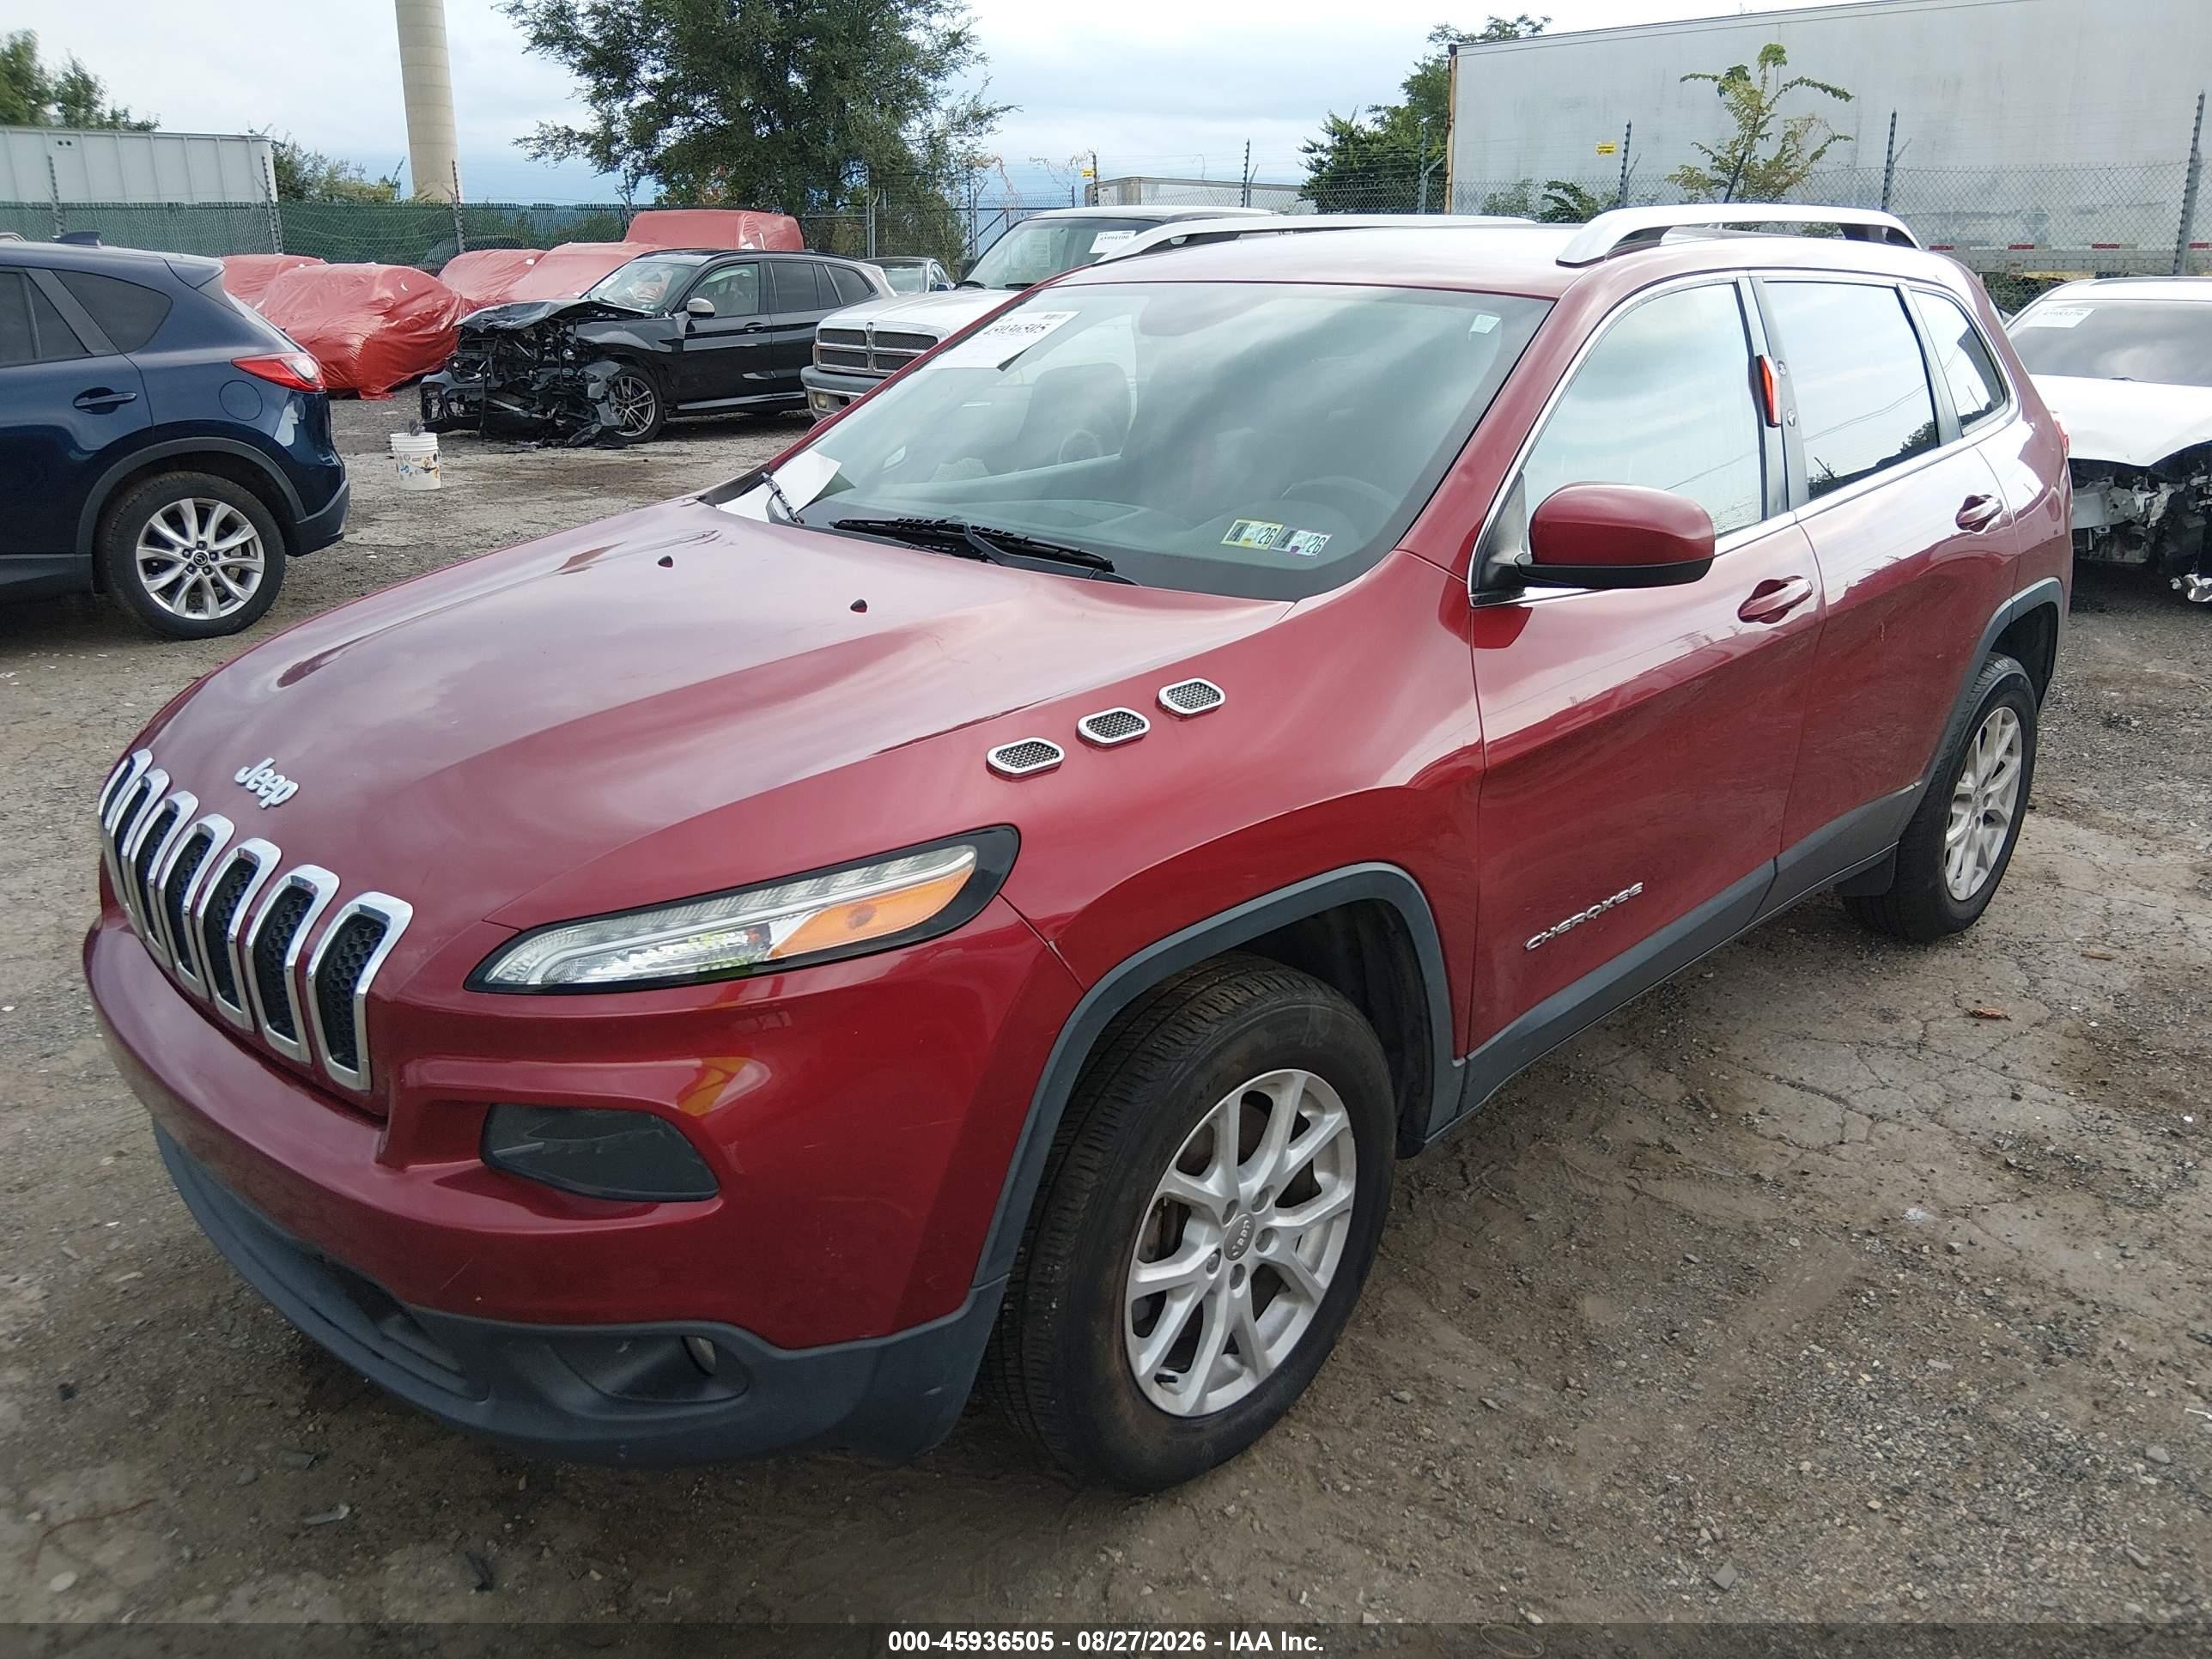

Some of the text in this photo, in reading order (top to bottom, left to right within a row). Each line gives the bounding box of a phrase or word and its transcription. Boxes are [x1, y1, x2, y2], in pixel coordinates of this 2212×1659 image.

[1258, 527, 1278, 544] 26
[1306, 536, 1327, 554] 26
[234, 757, 299, 809] Jeep
[1526, 882, 1644, 951] CHEROKEE
